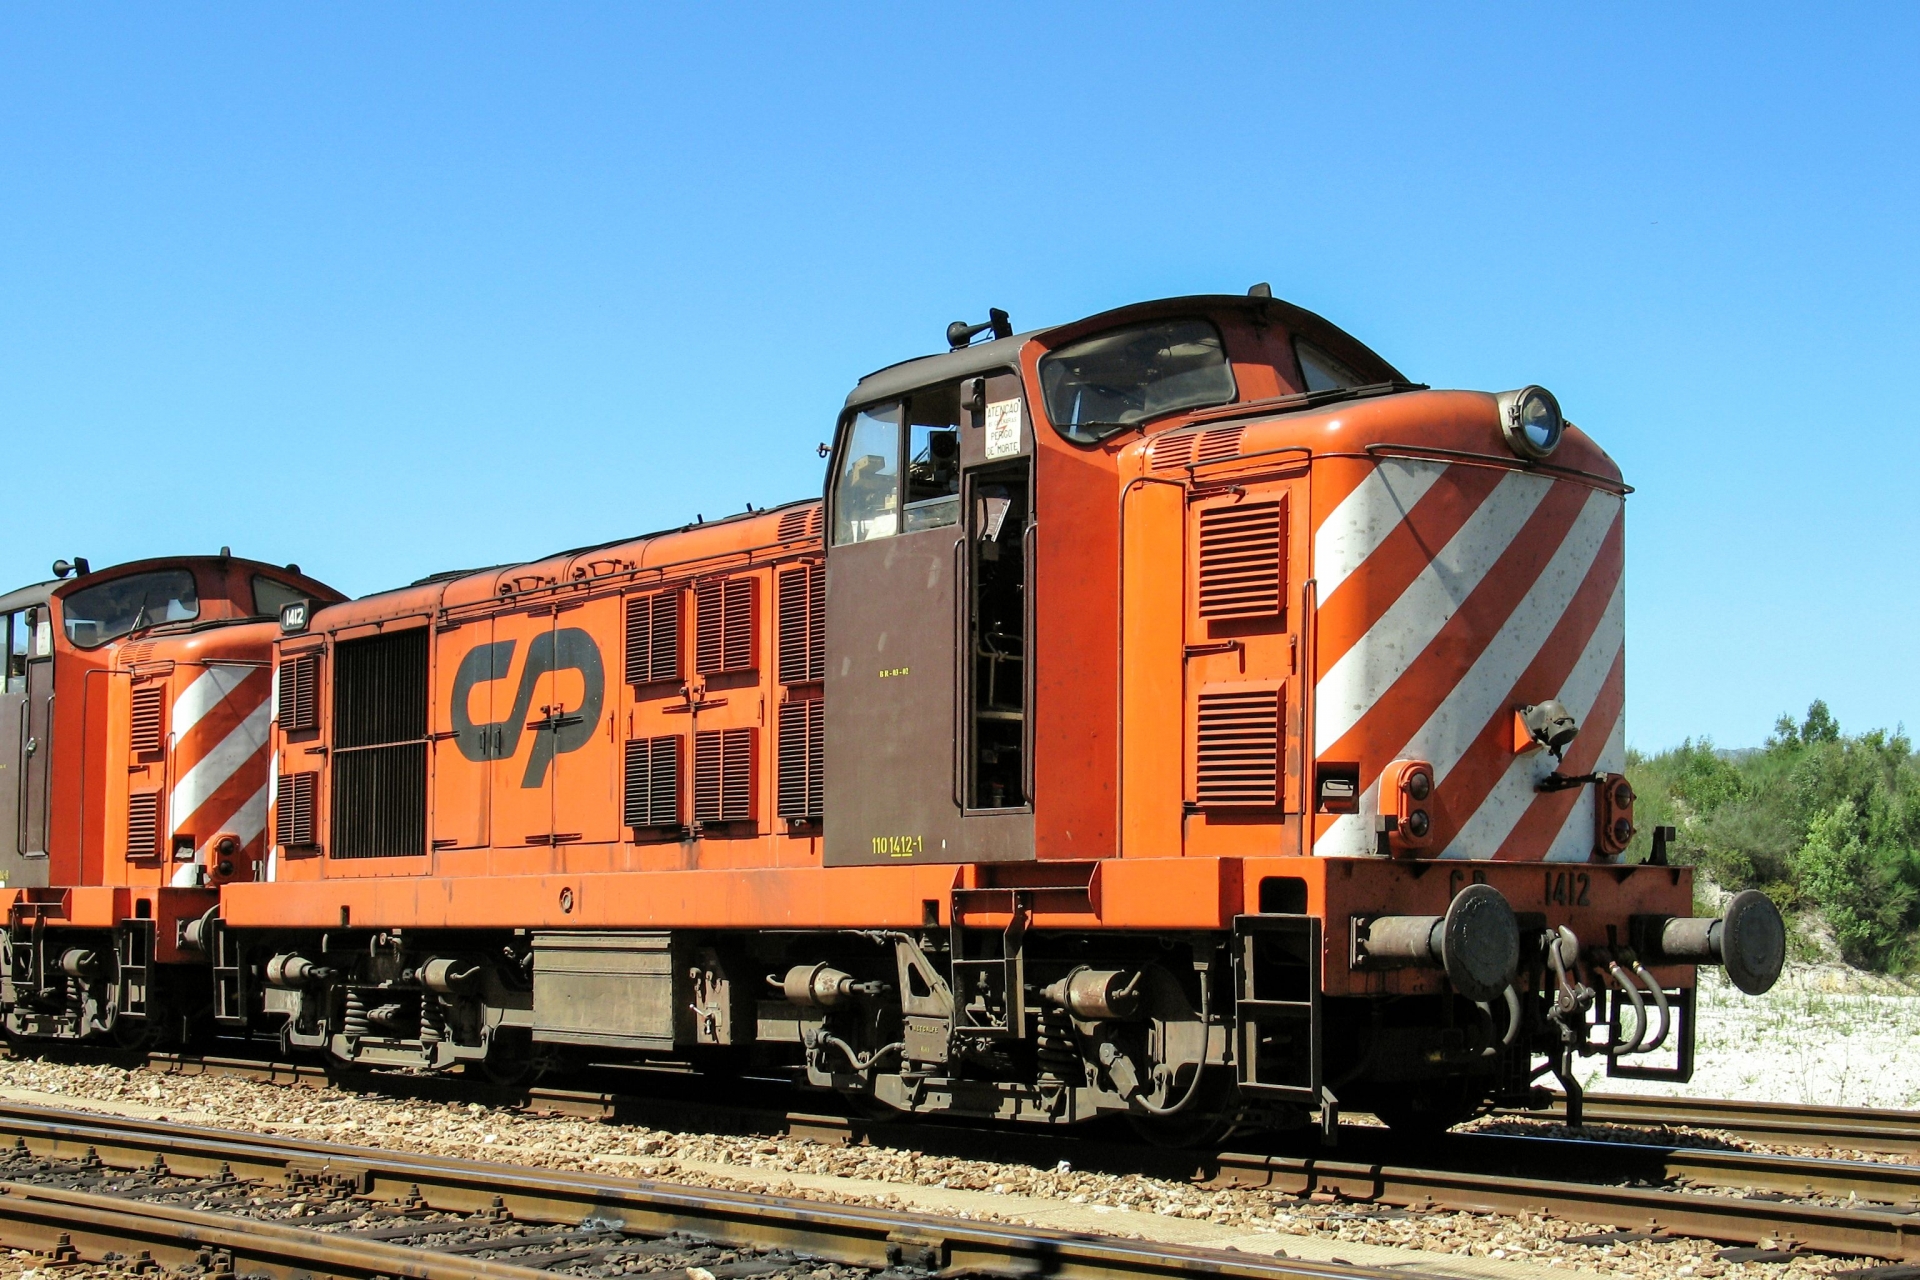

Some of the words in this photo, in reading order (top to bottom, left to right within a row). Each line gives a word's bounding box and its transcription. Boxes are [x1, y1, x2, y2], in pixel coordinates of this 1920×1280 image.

[987, 446, 994, 456] DE
[997, 441, 1018, 454] MORTE
[286, 607, 304, 626] 1412
[451, 627, 605, 788] CP
[1545, 872, 1591, 907] 1412
